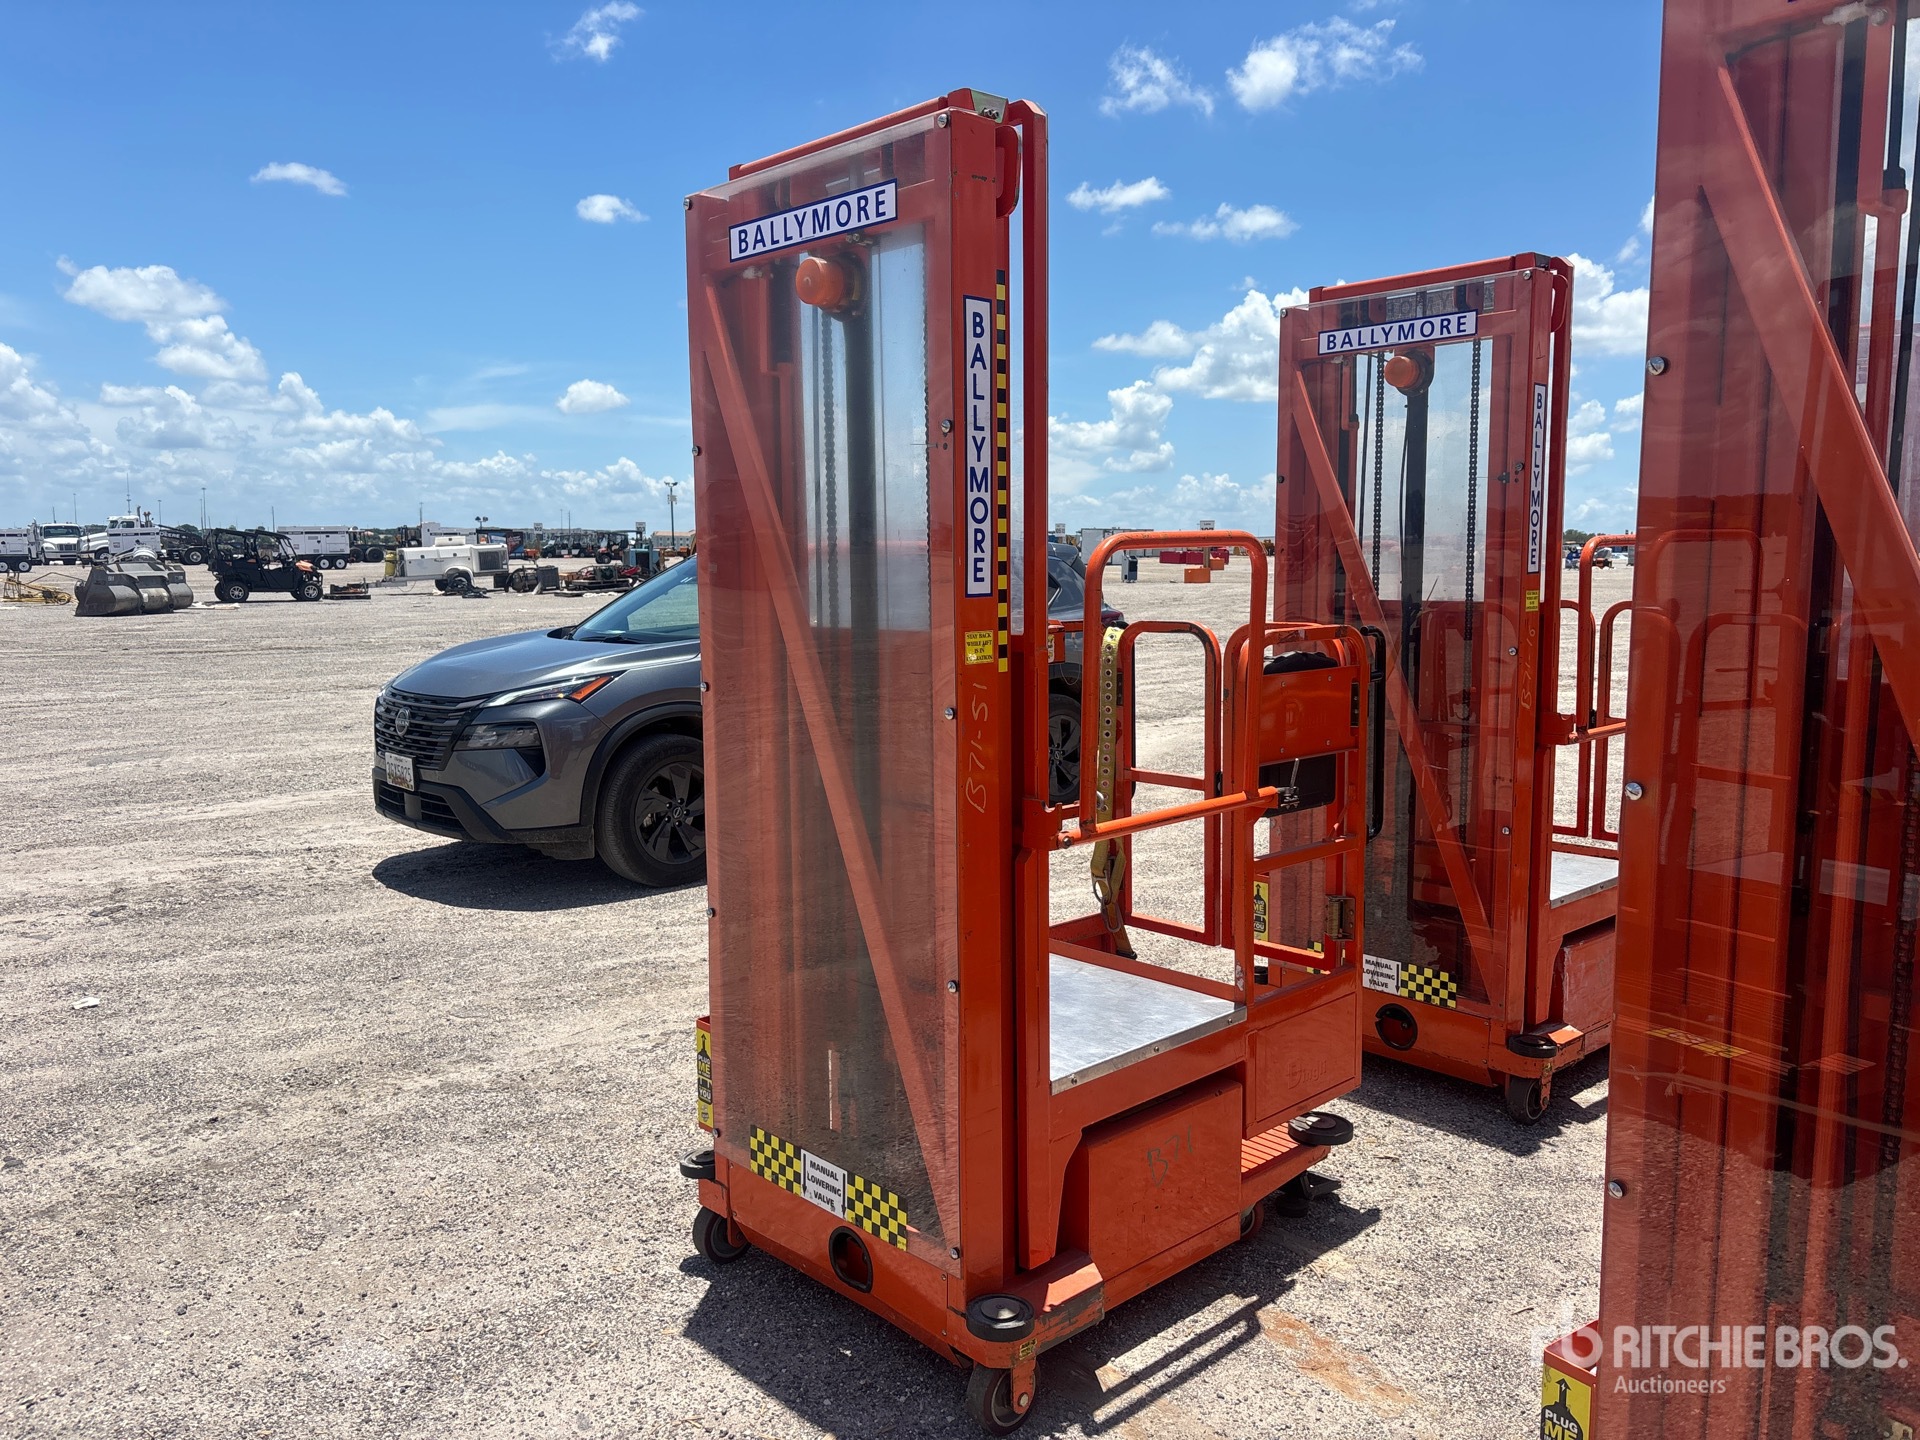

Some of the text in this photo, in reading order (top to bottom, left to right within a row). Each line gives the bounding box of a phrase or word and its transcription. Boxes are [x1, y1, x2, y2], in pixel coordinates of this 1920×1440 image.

[738, 189, 887, 254] BALLYMORE
[1326, 315, 1468, 351] BALLYMORE
[969, 311, 989, 583] BALLYMORE
[1530, 392, 1543, 565] BALLYMORE
[1363, 968, 1395, 981] LOWERING
[1365, 959, 1393, 970] MANUAL
[1369, 979, 1389, 988] VALVE
[810, 1160, 839, 1181] MANUAL
[807, 1171, 842, 1198] LOWERING
[813, 1190, 835, 1208] VALVE
[1545, 1409, 1578, 1434] PLUG
